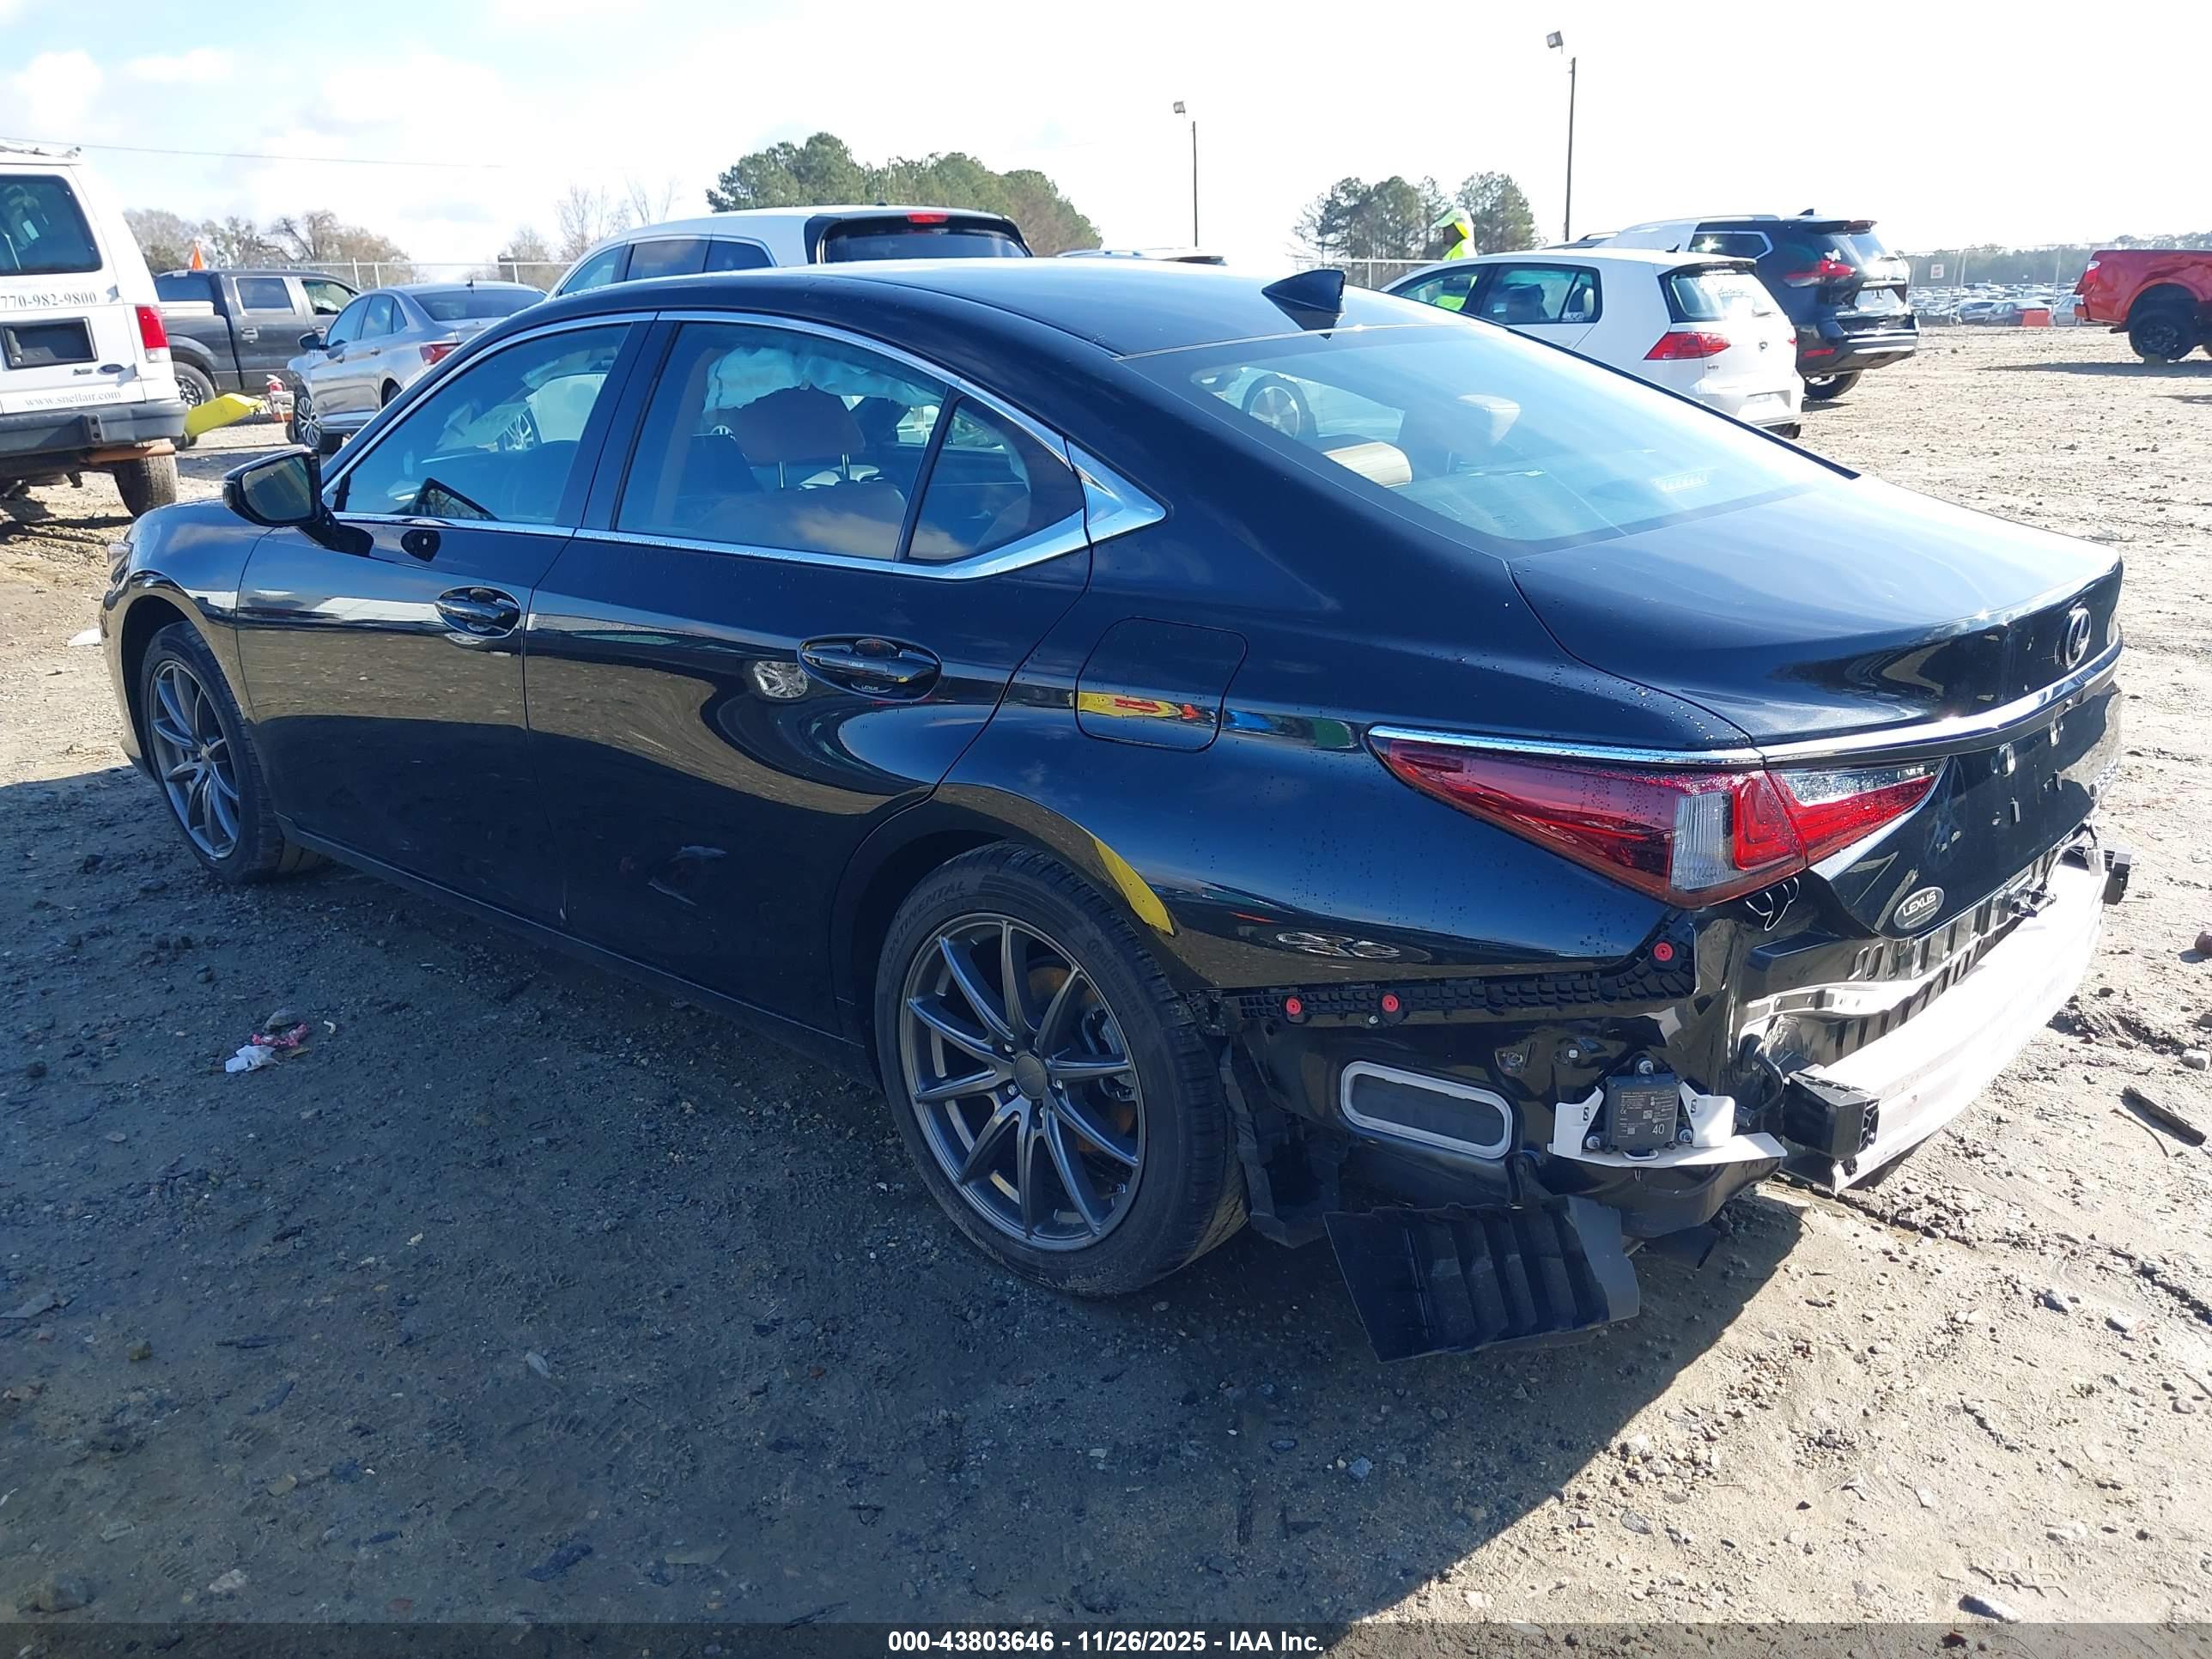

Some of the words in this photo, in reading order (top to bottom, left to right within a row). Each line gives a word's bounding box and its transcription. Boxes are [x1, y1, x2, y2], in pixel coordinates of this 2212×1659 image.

[0, 291, 97, 310] 770-982-9800
[24, 389, 122, 407] www.snellair.com
[1902, 890, 1937, 917] LEXUS
[1651, 1123, 1666, 1135] 40
